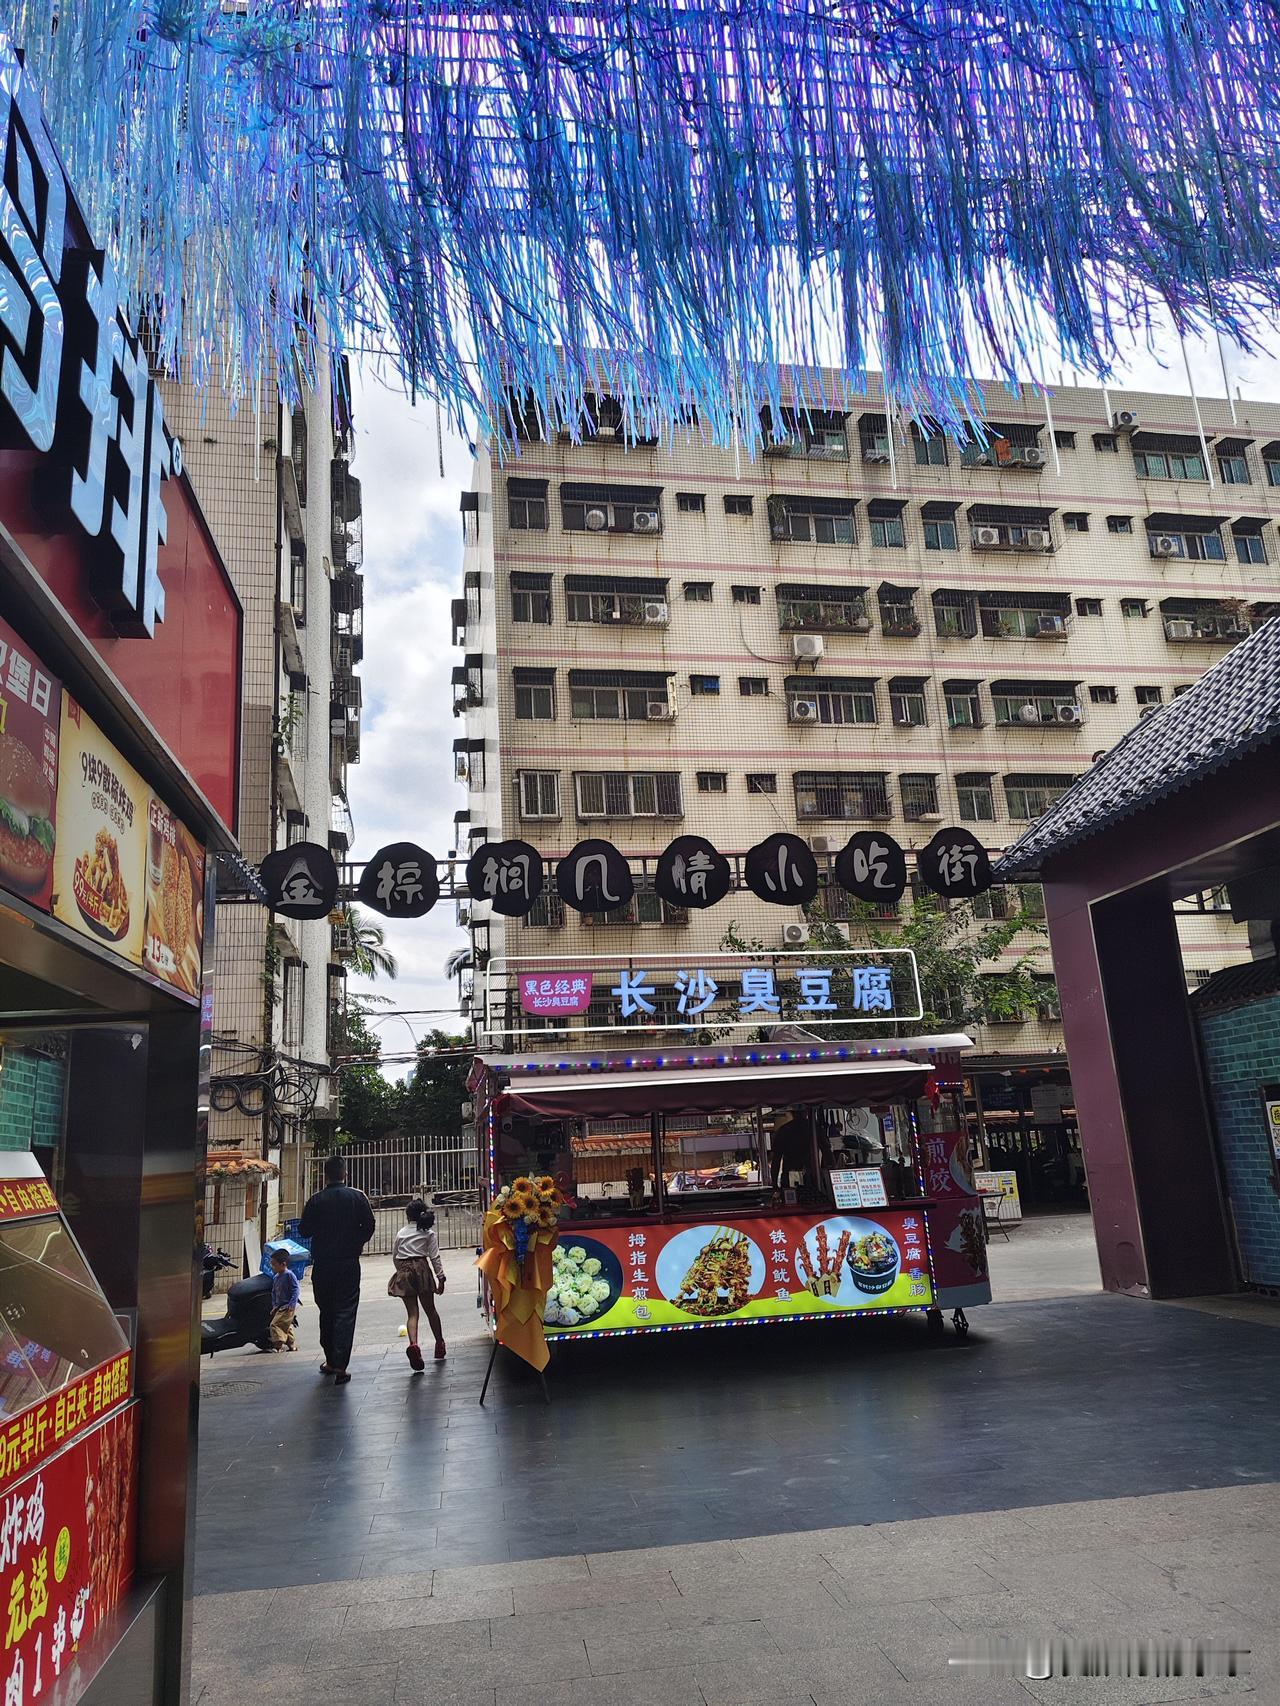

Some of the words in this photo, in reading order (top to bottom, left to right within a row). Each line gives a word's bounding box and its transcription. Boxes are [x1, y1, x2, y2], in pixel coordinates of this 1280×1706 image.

[525, 979, 586, 996] 黑色经典
[533, 996, 579, 1007] 长沙臭豆腐
[611, 967, 893, 1018] 长沙臭豆腐
[925, 1138, 952, 1192] 煎饺
[628, 1233, 652, 1320] 拇指生煎包
[769, 1229, 793, 1303] 铁板鱿鱼
